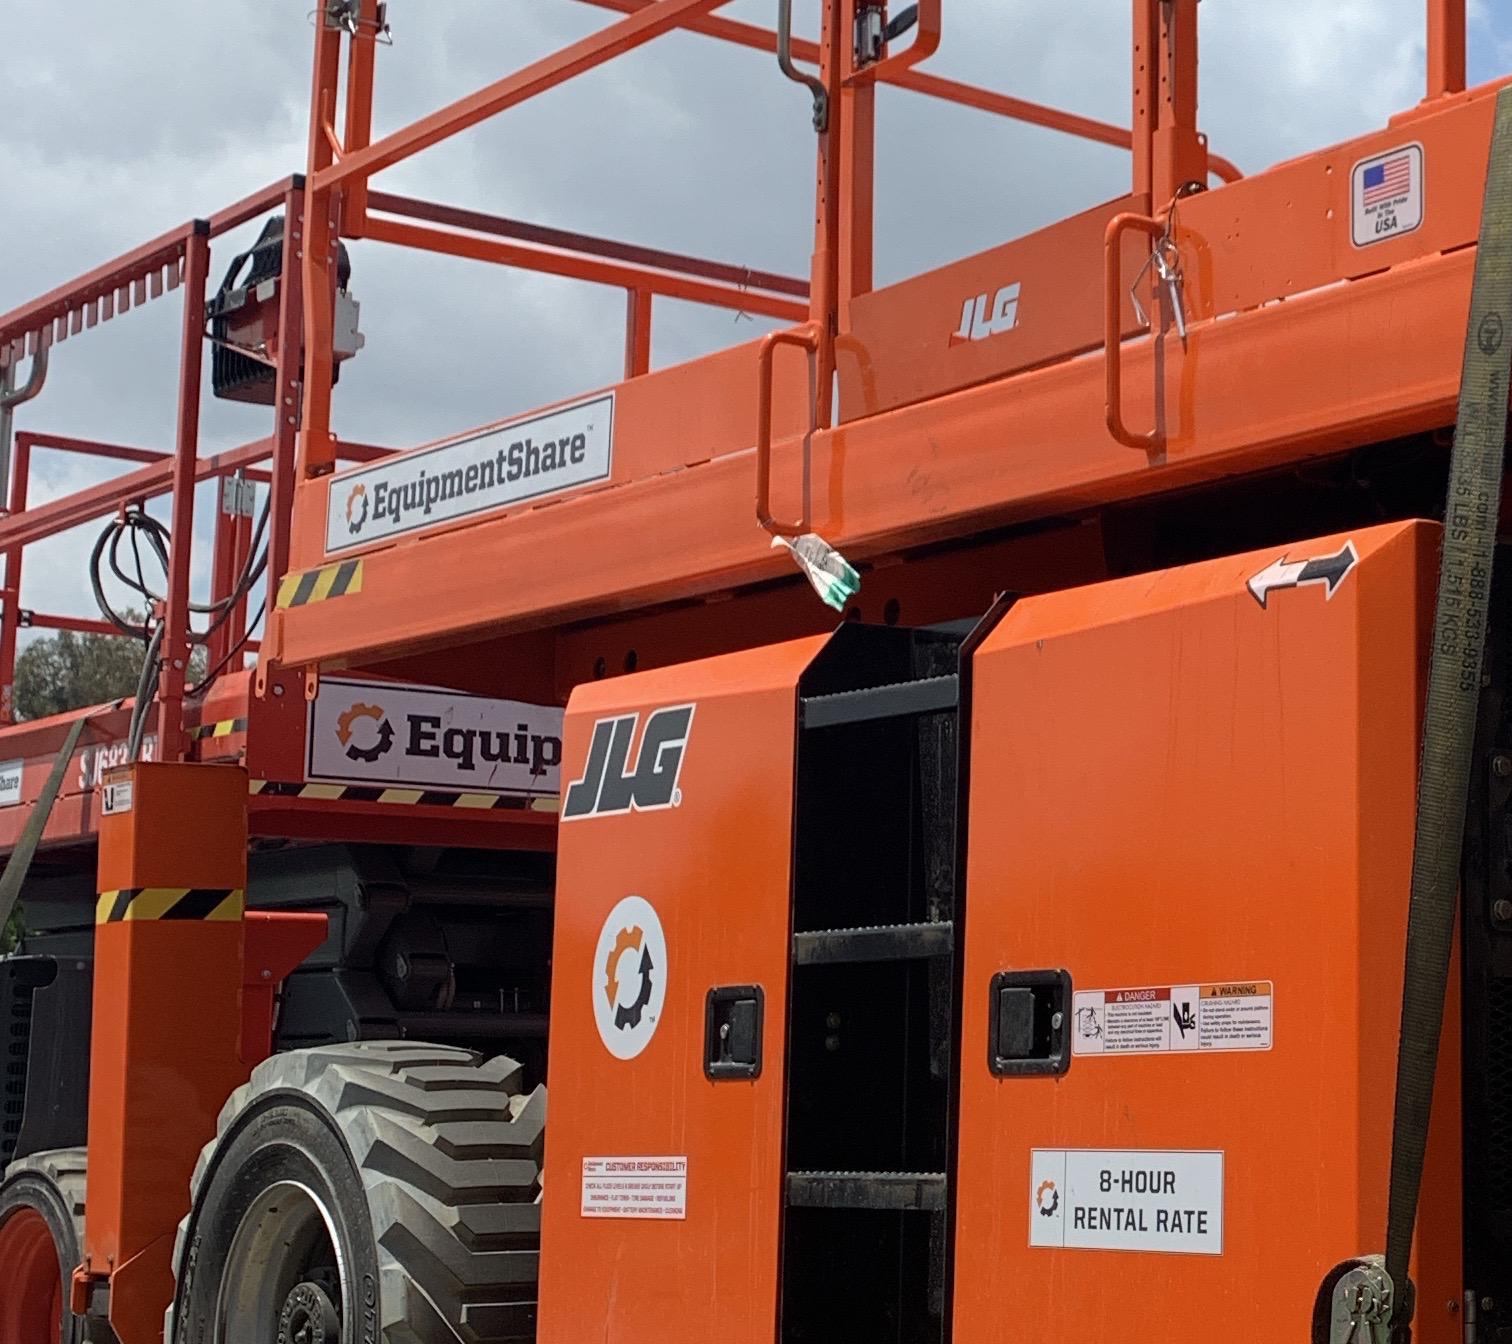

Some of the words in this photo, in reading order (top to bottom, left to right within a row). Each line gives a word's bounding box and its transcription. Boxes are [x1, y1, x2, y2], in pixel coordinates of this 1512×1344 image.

[1375, 215, 1398, 234] USA
[948, 281, 1021, 350] JLG
[371, 431, 587, 524] EquipmentShare
[1451, 502, 1471, 541] LBS
[1439, 613, 1461, 656] KGS
[405, 714, 562, 776] Equip
[561, 703, 697, 823] JLG
[0, 773, 20, 791] hare
[1124, 990, 1156, 1002] DANGER
[1219, 985, 1257, 996] WARNING
[605, 1162, 636, 1172] CUSTOMER
[636, 1161, 686, 1172] RESPONSIBILITY
[1099, 1169, 1176, 1194] 8-HOUR
[1074, 1207, 1148, 1232] RENTAL
[1156, 1209, 1208, 1234] RATE
